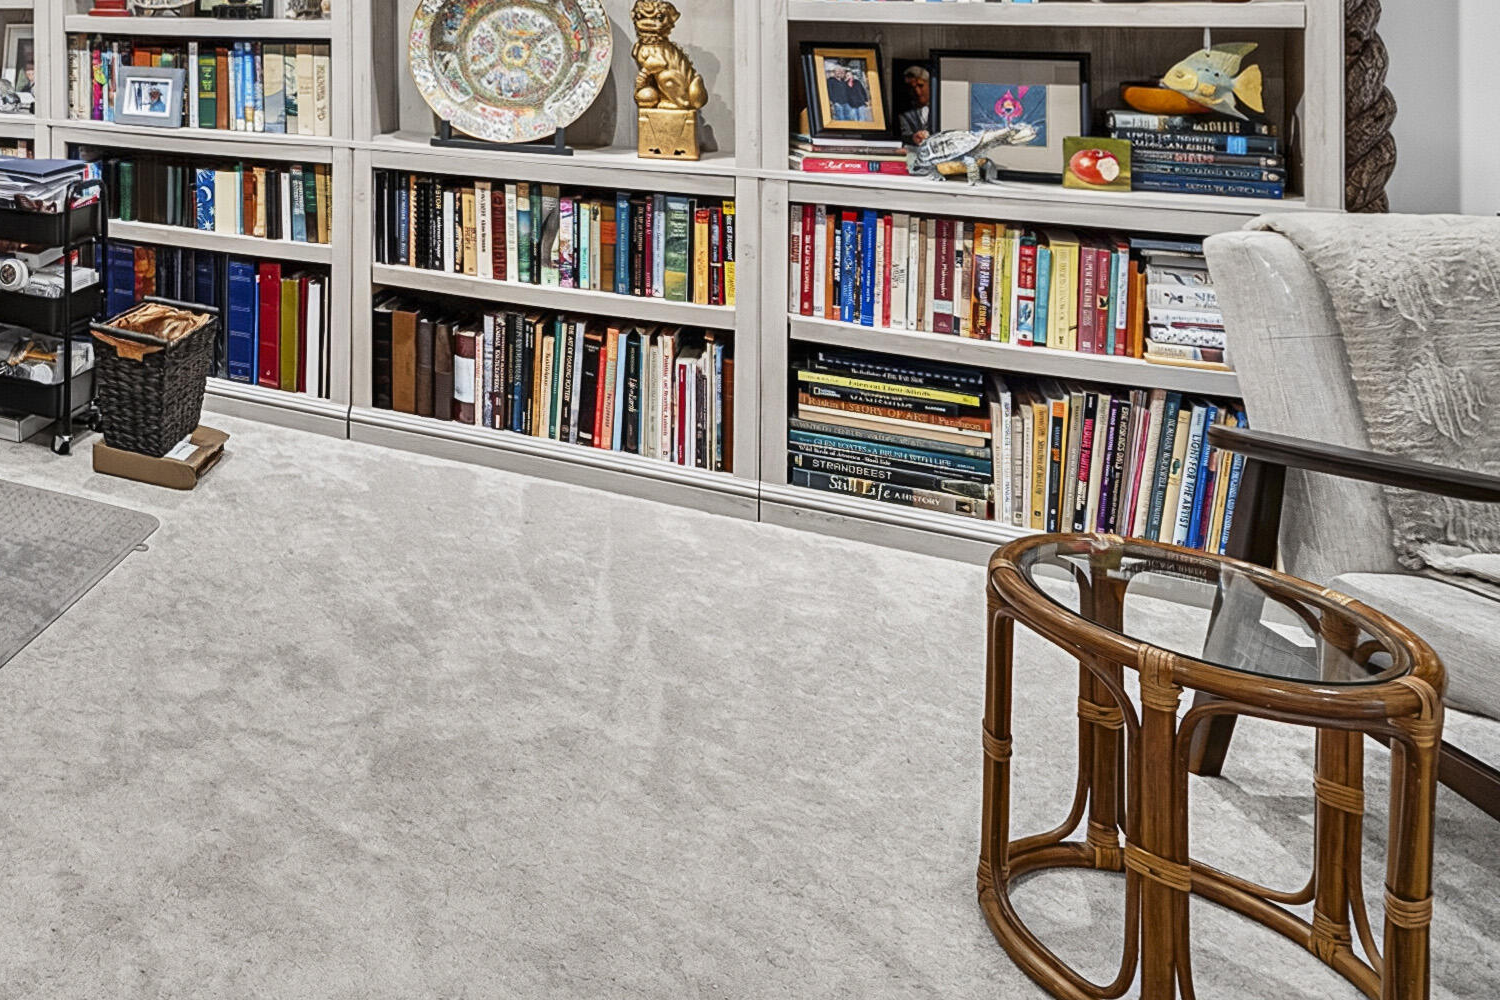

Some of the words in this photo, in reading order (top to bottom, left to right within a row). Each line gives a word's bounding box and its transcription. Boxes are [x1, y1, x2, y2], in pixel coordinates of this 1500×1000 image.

[627, 378, 638, 388] Life
[628, 394, 637, 413] Earth
[848, 402, 883, 416] STORY
[887, 408, 900, 418] OF
[905, 410, 928, 421] ART
[939, 416, 981, 431] Pantheon
[1121, 407, 1129, 420] ERIC
[1082, 419, 1094, 448] WILDLIFE
[1117, 421, 1128, 451] HOSKING'S
[1164, 419, 1176, 450] NORMAN
[1190, 434, 1201, 459] LIGHT
[813, 438, 837, 448] GLEN
[880, 449, 907, 459] BRUSH
[909, 453, 933, 464] WITH
[934, 457, 952, 467] LIFE
[837, 451, 861, 461] America
[1037, 440, 1045, 464] Sketches
[1078, 449, 1092, 481] PAINTING
[1115, 452, 1125, 470] OWLS
[812, 459, 892, 480] STRANDBEEST
[1158, 452, 1172, 487] ROCKWELL
[1187, 461, 1197, 479] FOR
[828, 474, 858, 493] Still
[862, 479, 891, 501] Life
[902, 493, 941, 506] HISTORY
[1184, 482, 1194, 498] THE
[1152, 490, 1163, 525] ILLUSTRATOR
[1179, 498, 1192, 528] ARTIST
